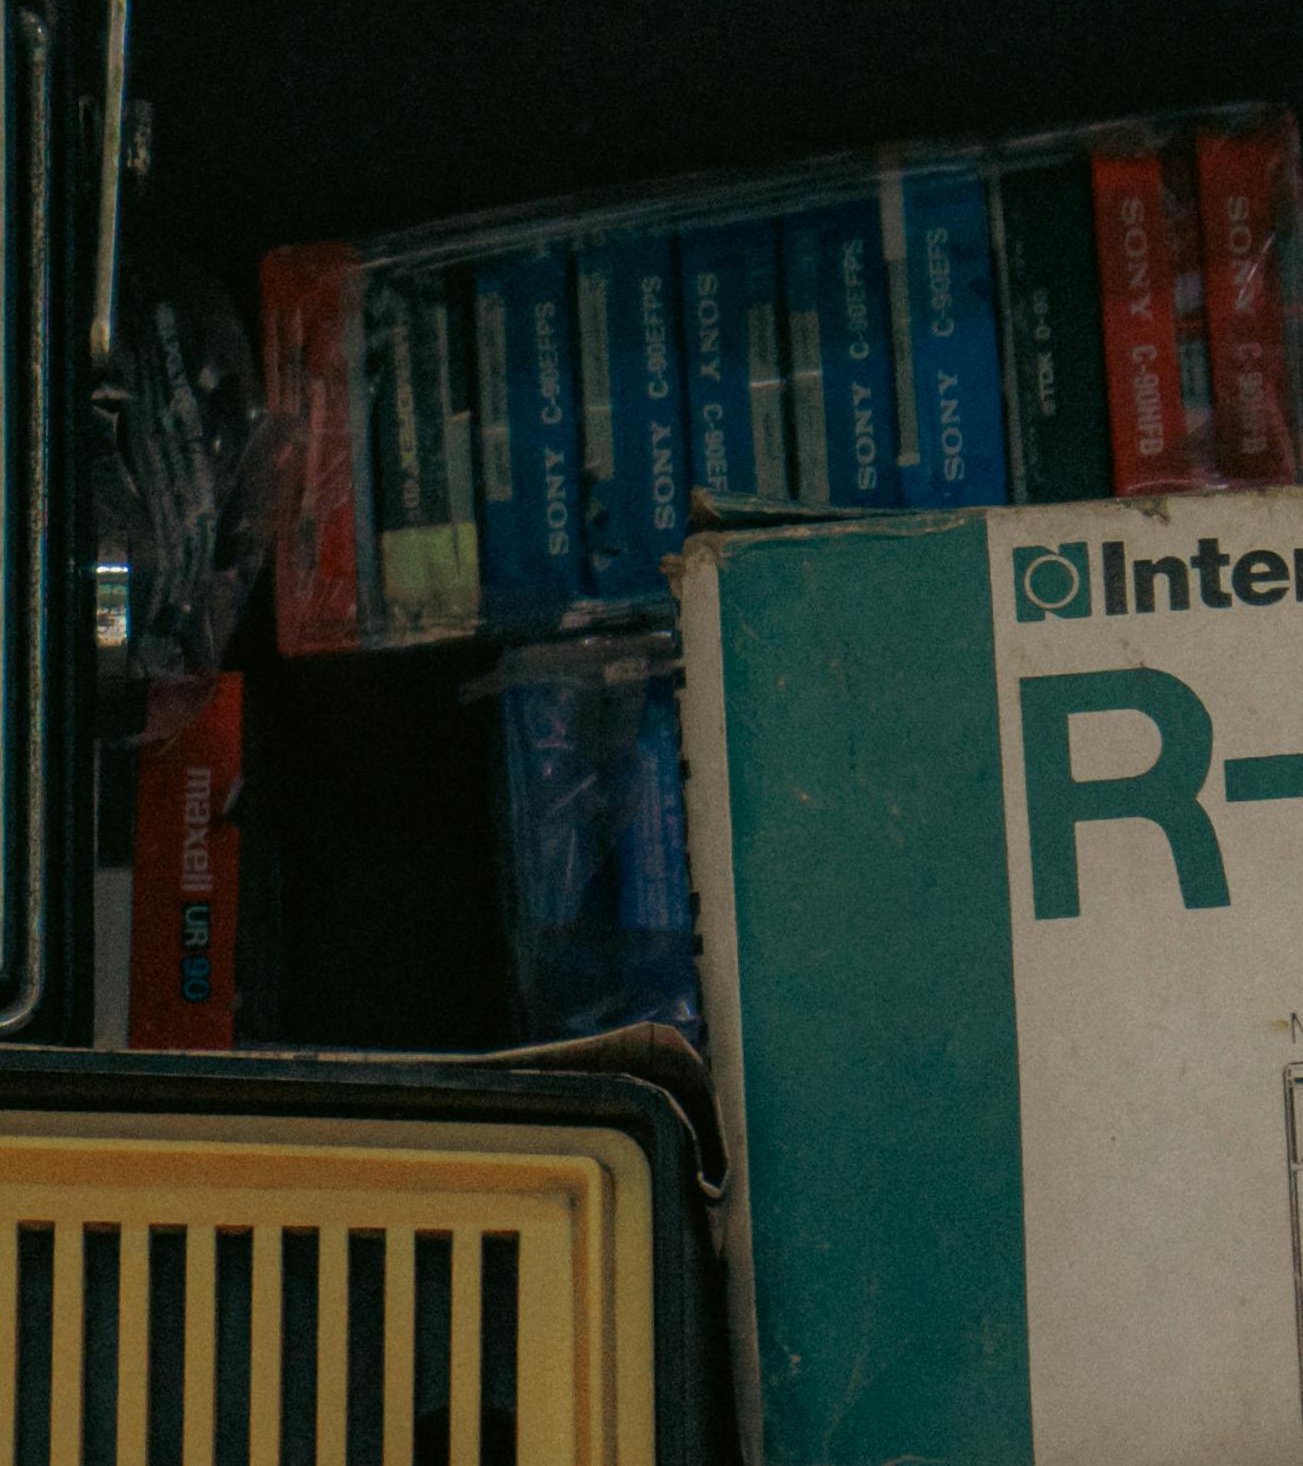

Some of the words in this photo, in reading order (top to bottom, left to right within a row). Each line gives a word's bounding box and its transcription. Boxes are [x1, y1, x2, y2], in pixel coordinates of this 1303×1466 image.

[1121, 197, 1153, 321] SONY
[1226, 195, 1257, 318] SONY
[697, 272, 721, 382] SONY
[651, 422, 676, 530] SONY
[851, 381, 877, 491] SONY
[937, 369, 966, 482] SONY
[544, 446, 569, 556] SONY
[180, 766, 214, 892] maxell
[181, 956, 211, 1000] 90
[183, 905, 210, 948] UR
